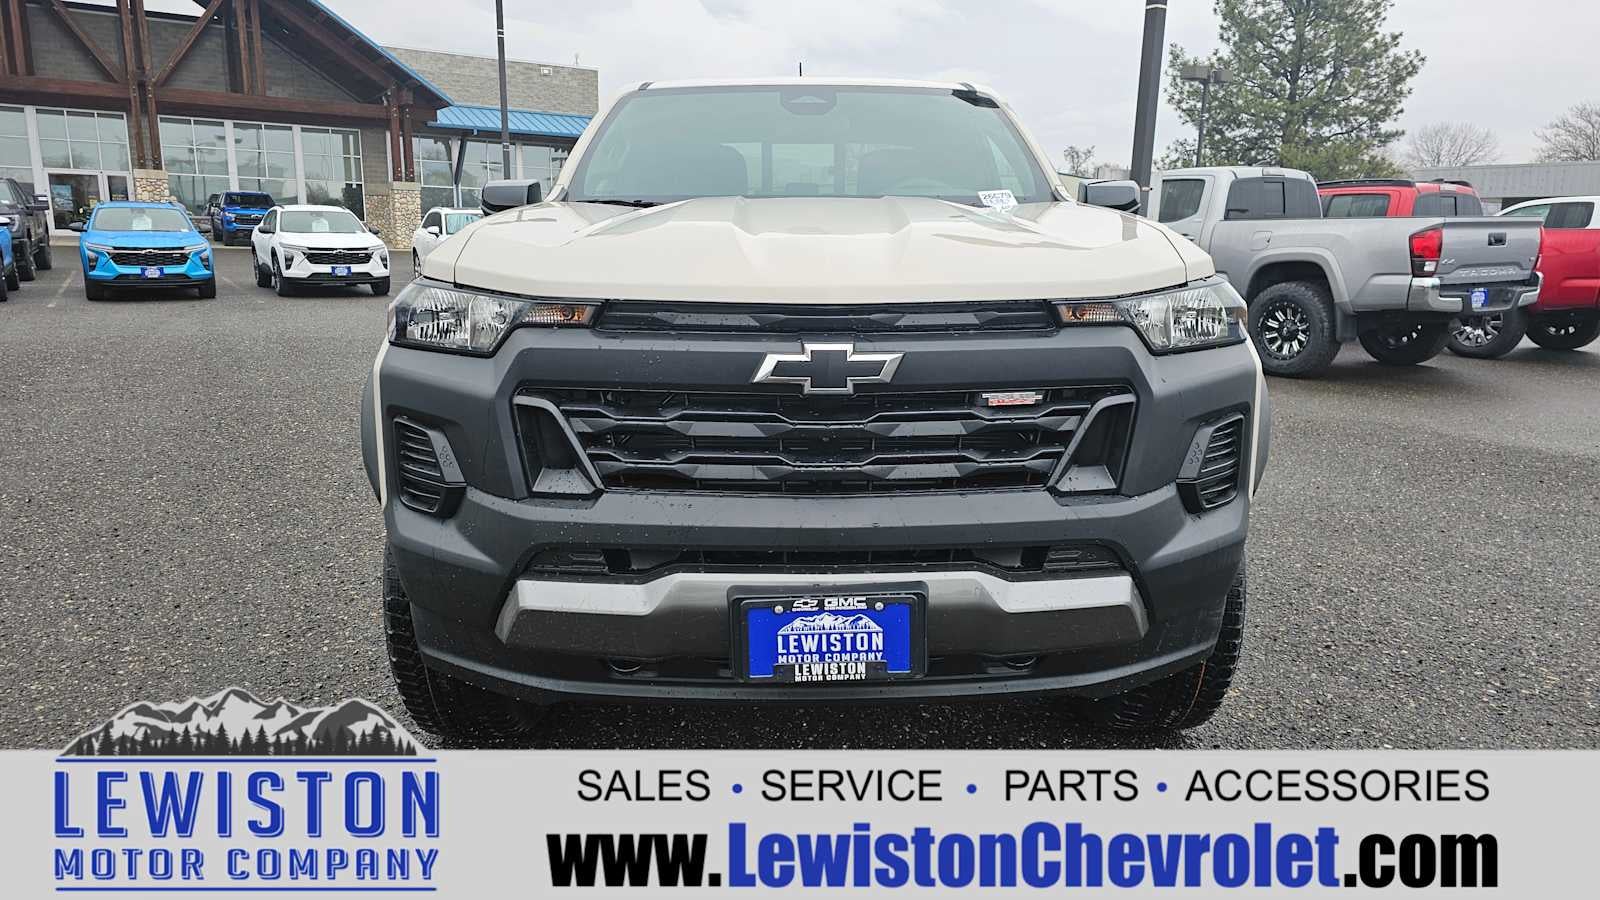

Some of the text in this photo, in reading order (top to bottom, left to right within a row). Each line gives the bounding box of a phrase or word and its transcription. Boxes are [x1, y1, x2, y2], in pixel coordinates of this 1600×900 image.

[824, 597, 867, 607] GMC
[777, 633, 884, 653] LEWISTON
[778, 652, 883, 663] MOTOR COMPANY
[794, 662, 866, 676] LEWISTON
[826, 673, 866, 681] COMPANY
